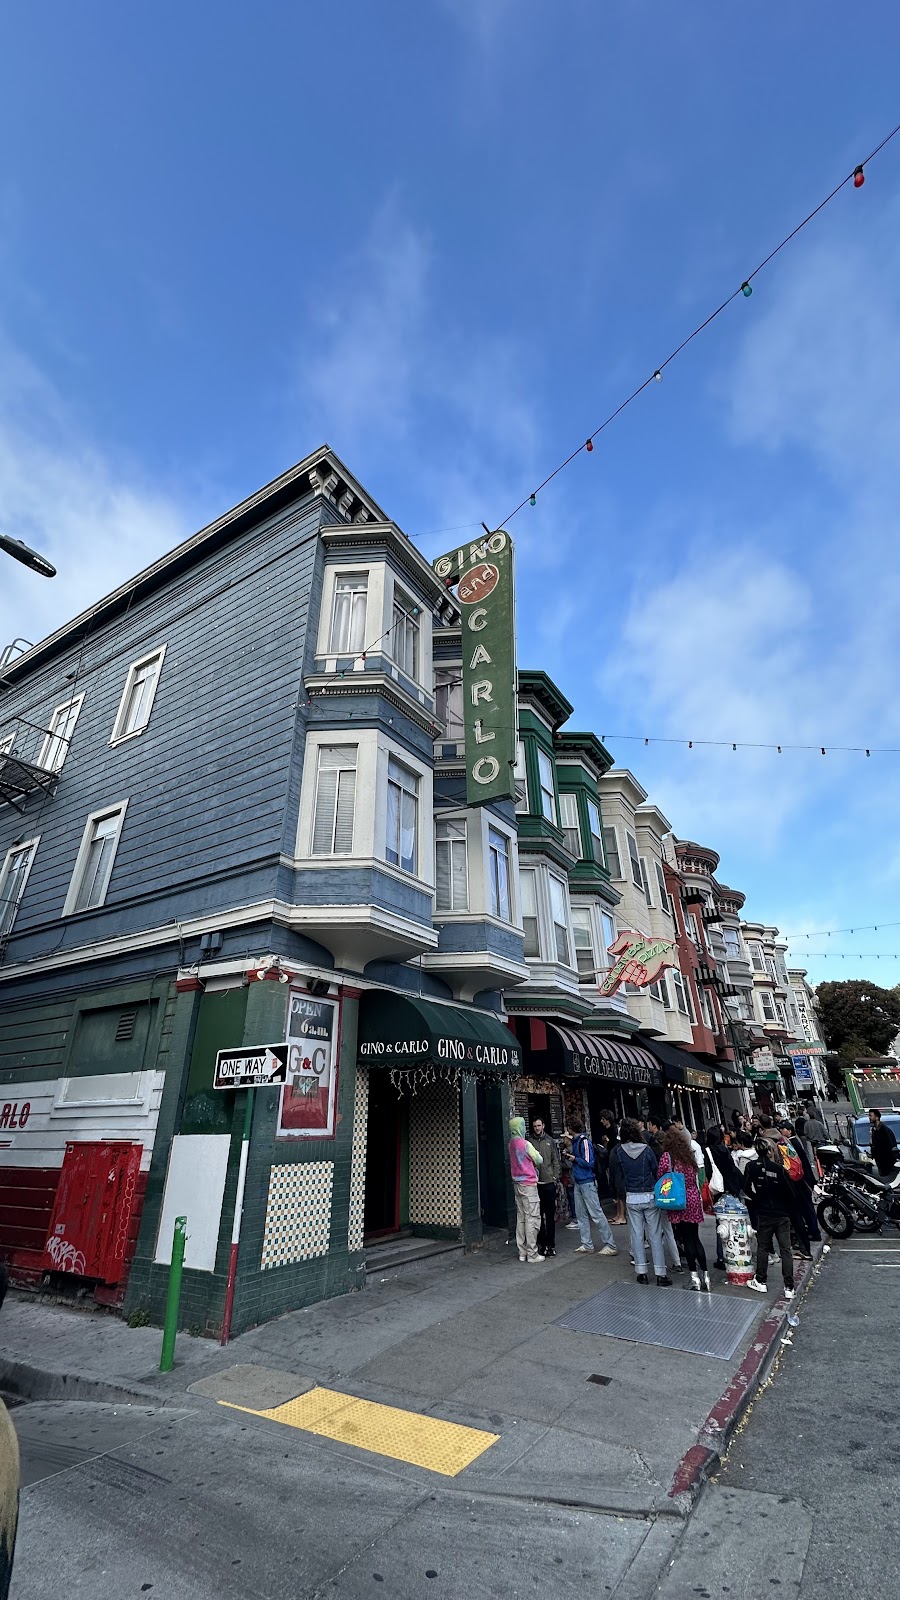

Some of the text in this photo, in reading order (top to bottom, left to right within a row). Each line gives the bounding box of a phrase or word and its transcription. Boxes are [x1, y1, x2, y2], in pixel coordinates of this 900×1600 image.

[434, 532, 506, 577] GINO
[460, 563, 495, 599] and
[468, 608, 499, 785] CARLO
[603, 938, 645, 990] GOLDEN BOY
[637, 941, 673, 966] PIZZA
[291, 999, 322, 1017] OPEN
[798, 1007, 812, 1041] MARKET
[360, 1039, 429, 1055] GINO & CARLO
[437, 1038, 465, 1060] GINO
[466, 1046, 474, 1060] &
[475, 1044, 508, 1066] CARLO
[221, 1057, 267, 1076] ONE WAY
[584, 1056, 618, 1078] GOLDEN
[617, 1063, 633, 1080] BOY
[632, 1066, 652, 1084] PIZZA
